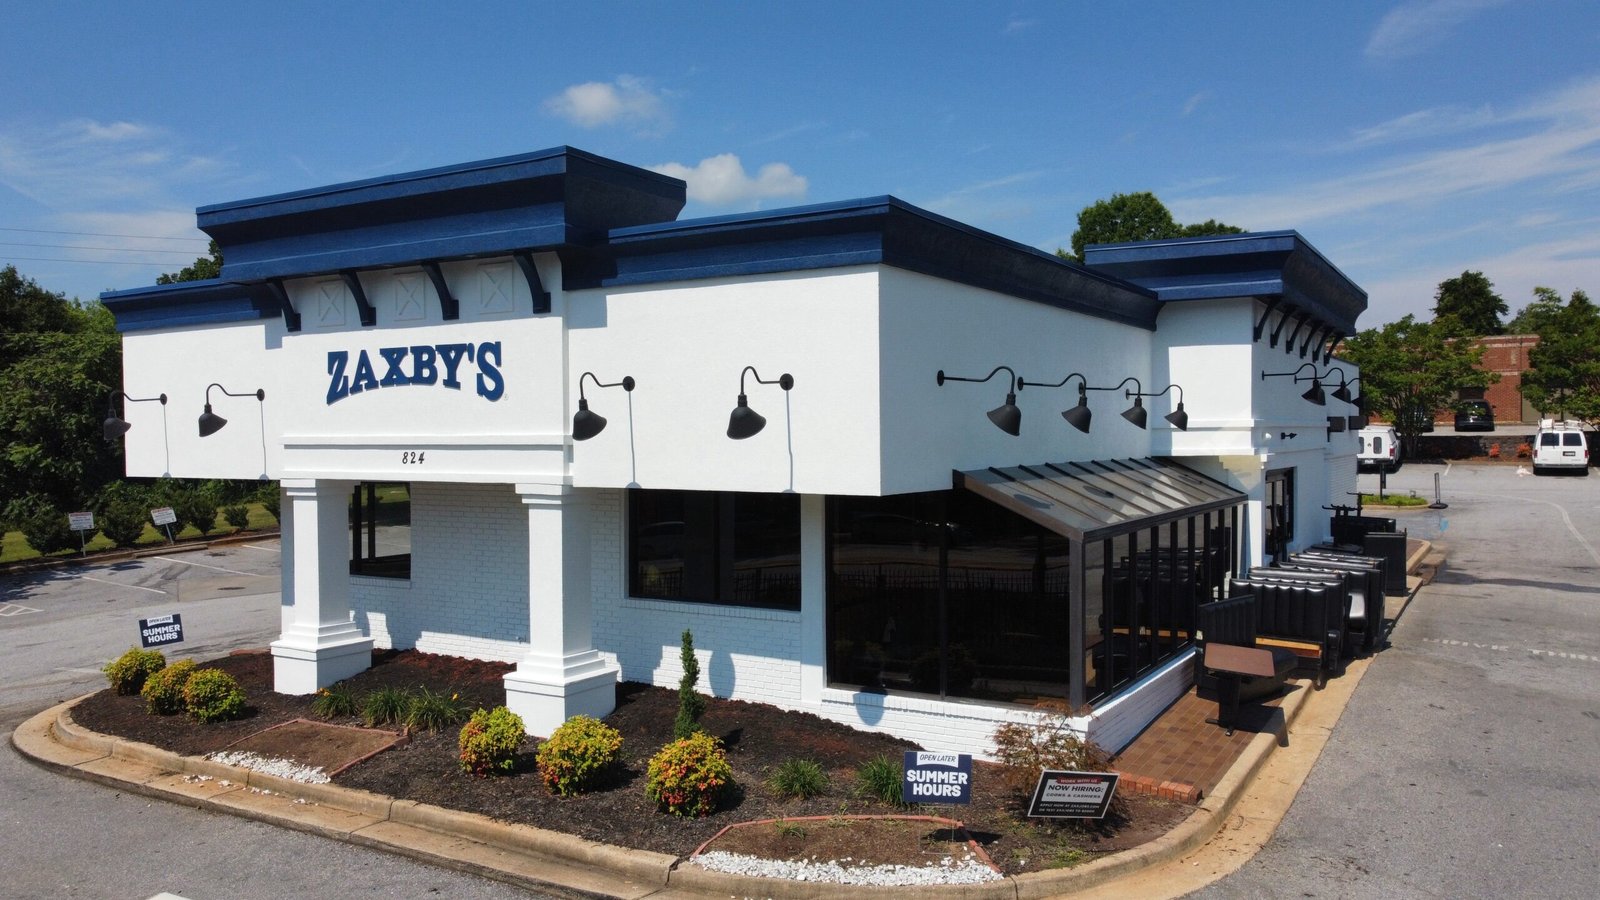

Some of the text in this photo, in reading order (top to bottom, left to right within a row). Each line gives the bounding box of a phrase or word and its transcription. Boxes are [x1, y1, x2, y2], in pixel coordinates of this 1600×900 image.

[326, 341, 505, 406] ZAXBY'S
[402, 451, 425, 464] 824
[142, 624, 180, 637] SUMMER
[147, 632, 178, 643] HOURS
[937, 754, 957, 762] LATER
[906, 769, 968, 785] SUMMER
[912, 783, 962, 797] HOURS
